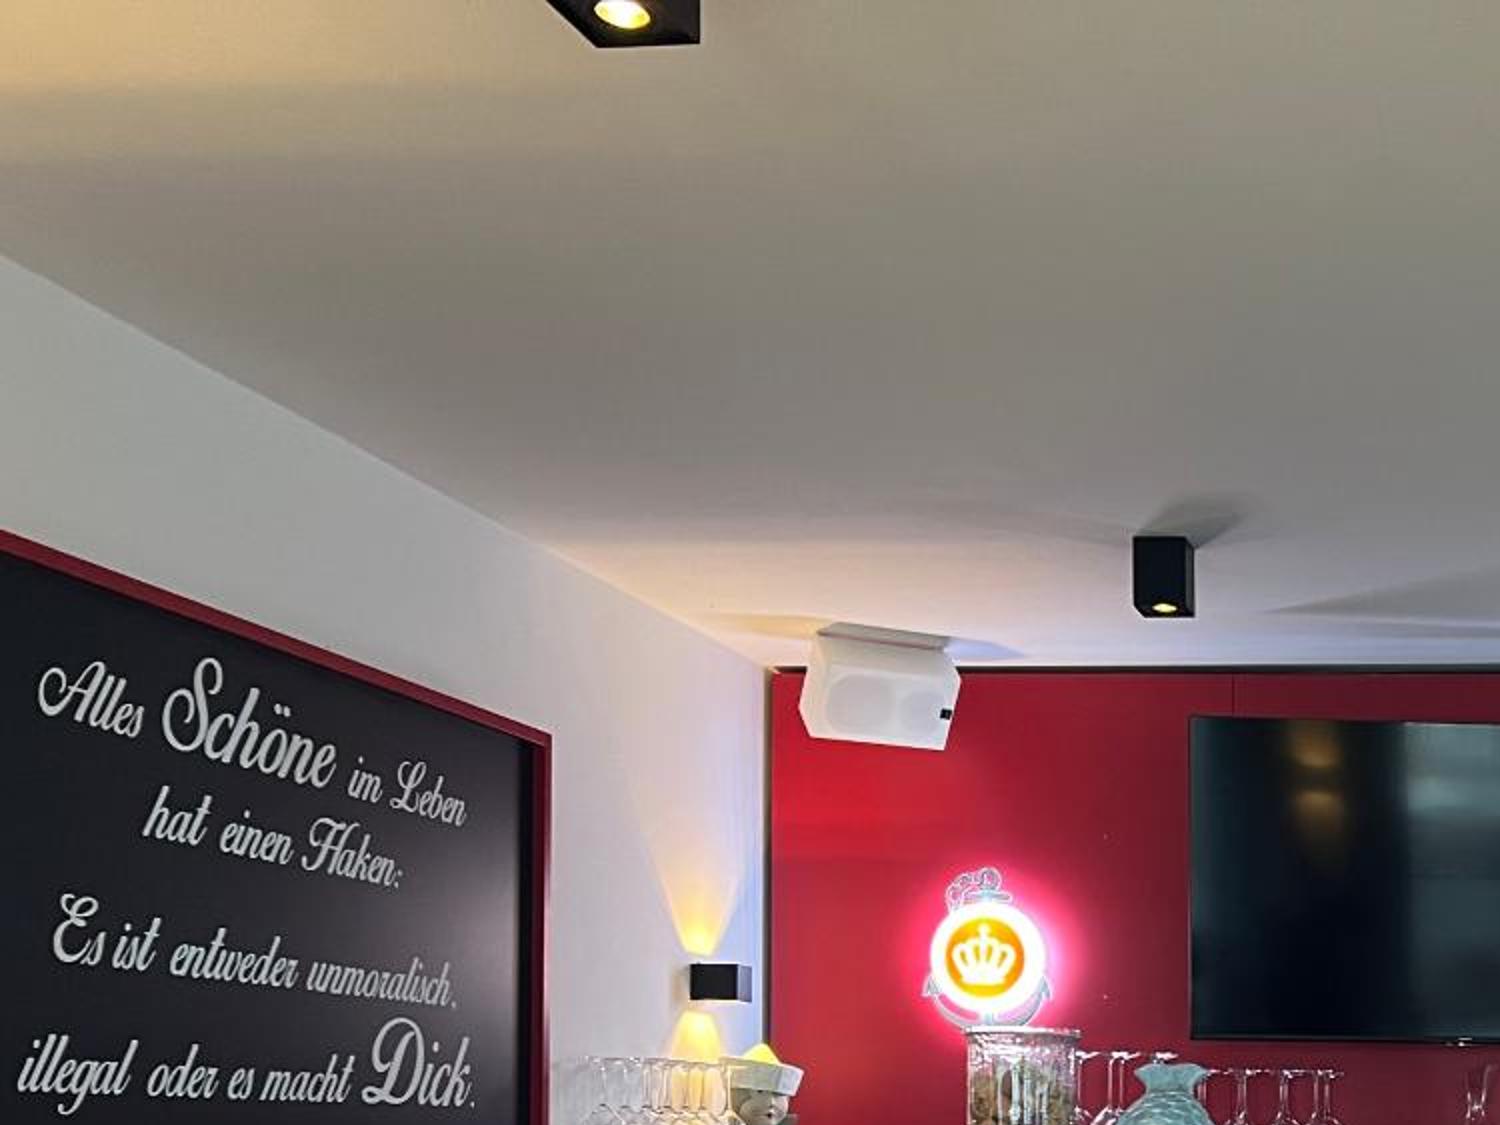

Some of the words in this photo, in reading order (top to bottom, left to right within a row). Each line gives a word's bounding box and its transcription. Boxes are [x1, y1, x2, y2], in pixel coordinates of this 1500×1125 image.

[38, 660, 144, 739] Alles
[161, 658, 337, 789] Schöne
[347, 755, 384, 804] im
[389, 760, 467, 828] Leben
[141, 784, 213, 847] hat
[219, 809, 295, 866] einen
[300, 817, 404, 889] Haken:
[53, 893, 107, 966] Es
[112, 916, 162, 972] ist
[169, 927, 300, 990] entweder
[17, 1033, 140, 1117] illegal
[146, 1042, 220, 1100] oder
[226, 1067, 256, 1102] es
[258, 1052, 356, 1104] macht
[360, 1017, 476, 1109] Dick.
